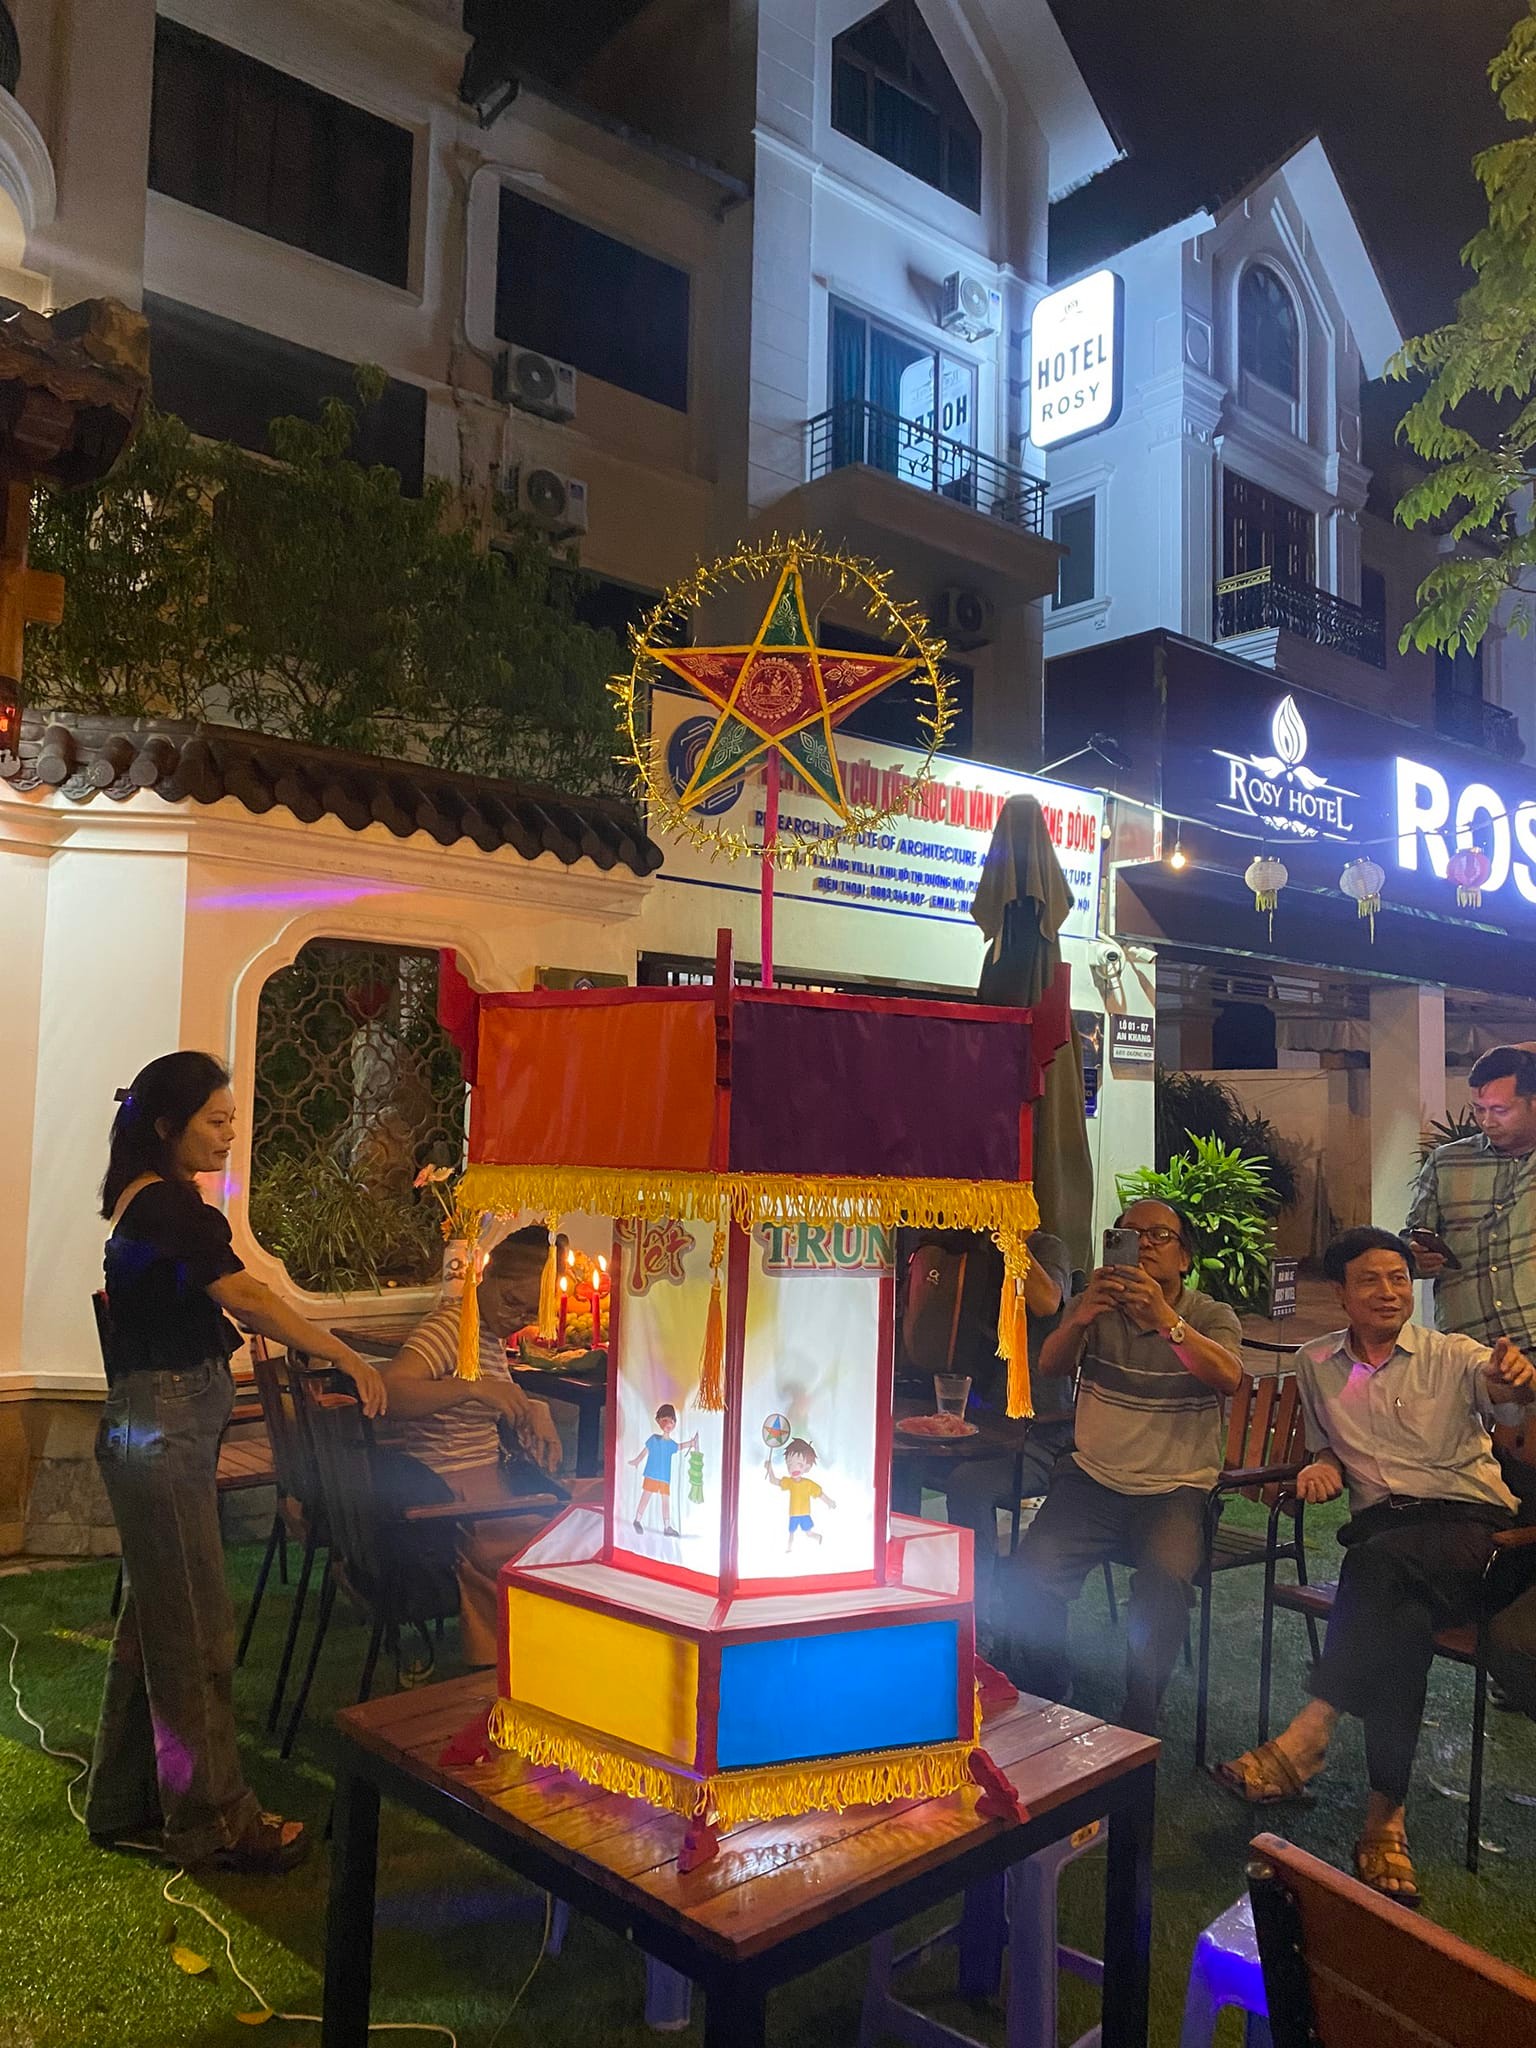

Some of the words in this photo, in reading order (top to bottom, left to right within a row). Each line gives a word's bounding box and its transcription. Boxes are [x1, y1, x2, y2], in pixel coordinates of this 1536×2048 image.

[1037, 334, 1107, 390] HOTEL
[1041, 382, 1100, 423] ROSY
[1229, 760, 1284, 816] ROSY
[1288, 789, 1353, 832] HOTEL
[755, 810, 819, 836] REARCH
[881, 833, 896, 850] OF
[899, 838, 977, 867] ARCHITECTURE
[1116, 1032, 1127, 1041] AN
